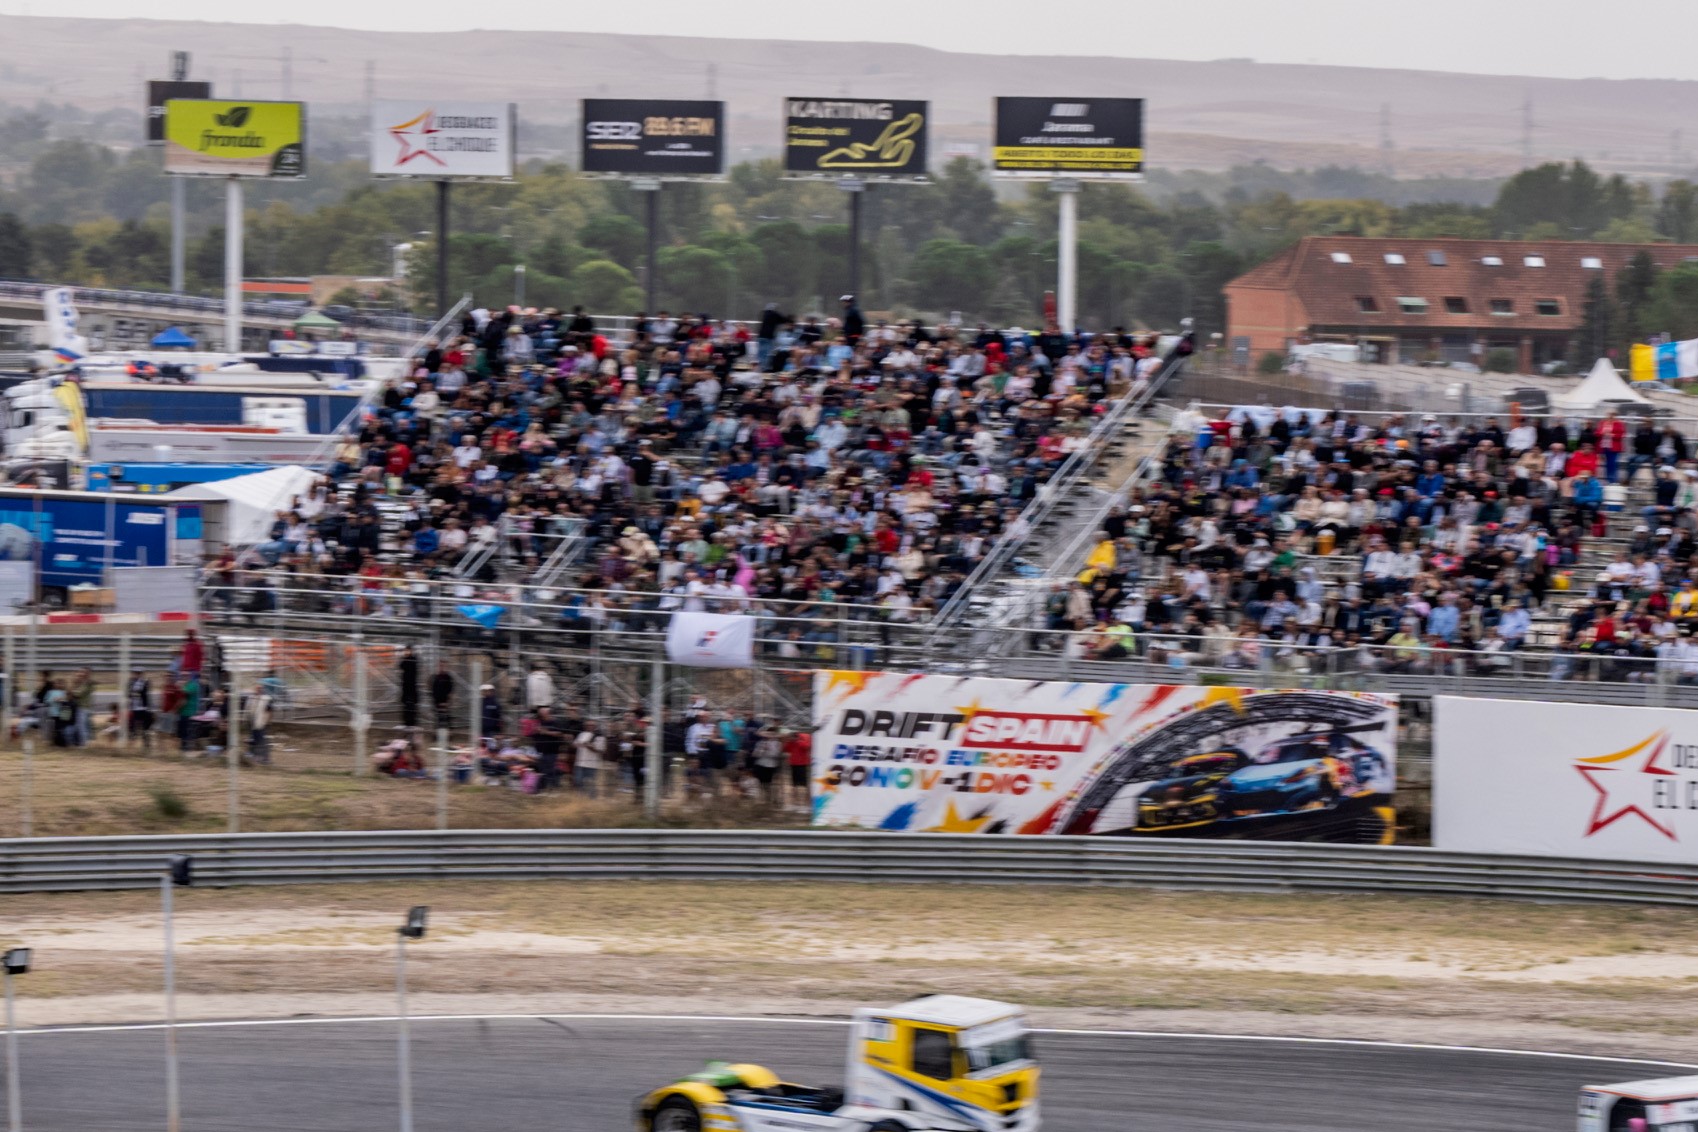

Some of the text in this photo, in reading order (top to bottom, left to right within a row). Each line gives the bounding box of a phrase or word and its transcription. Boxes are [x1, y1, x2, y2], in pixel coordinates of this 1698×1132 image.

[840, 709, 1086, 746] DRIFT SPAIN
[945, 750, 1061, 770] EUROPEO
[1652, 779, 1680, 810] EL
